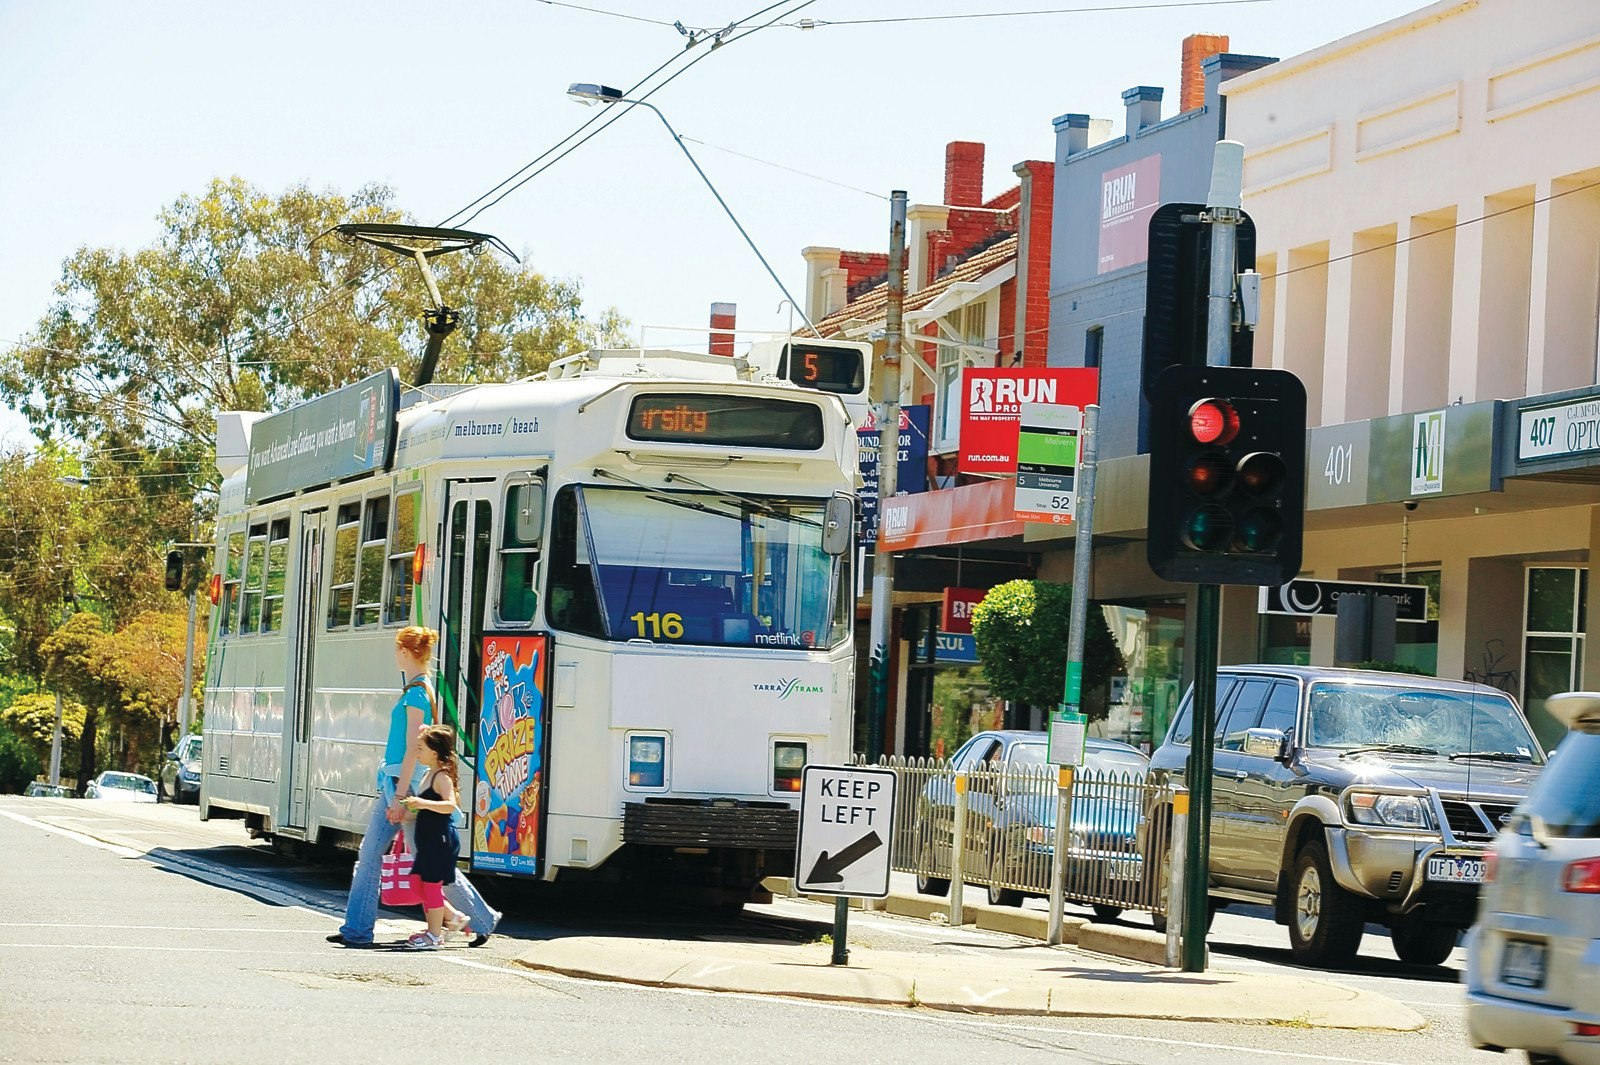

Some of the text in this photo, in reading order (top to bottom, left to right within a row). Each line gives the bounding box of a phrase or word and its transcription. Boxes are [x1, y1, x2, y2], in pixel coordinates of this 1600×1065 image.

[1112, 172, 1136, 207] RUN
[804, 353, 818, 381] 5
[996, 378, 1057, 403] RUN
[454, 420, 502, 437] melbourne
[512, 416, 539, 434] beach
[1530, 416, 1556, 447] 407
[1044, 437, 1074, 446] Malvern
[968, 454, 1010, 463] run.com.au
[1324, 443, 1353, 486] 401
[1018, 476, 1026, 485] 5
[1051, 495, 1070, 510] 52
[630, 612, 685, 639] 116
[755, 632, 801, 646] metlink
[753, 684, 824, 693] YARRA TRAMS
[484, 717, 536, 789] PRIZE
[497, 755, 529, 801] TIME
[820, 778, 881, 800] KEEP
[821, 804, 877, 826] LEFT
[1430, 860, 1487, 878] UFI 299
